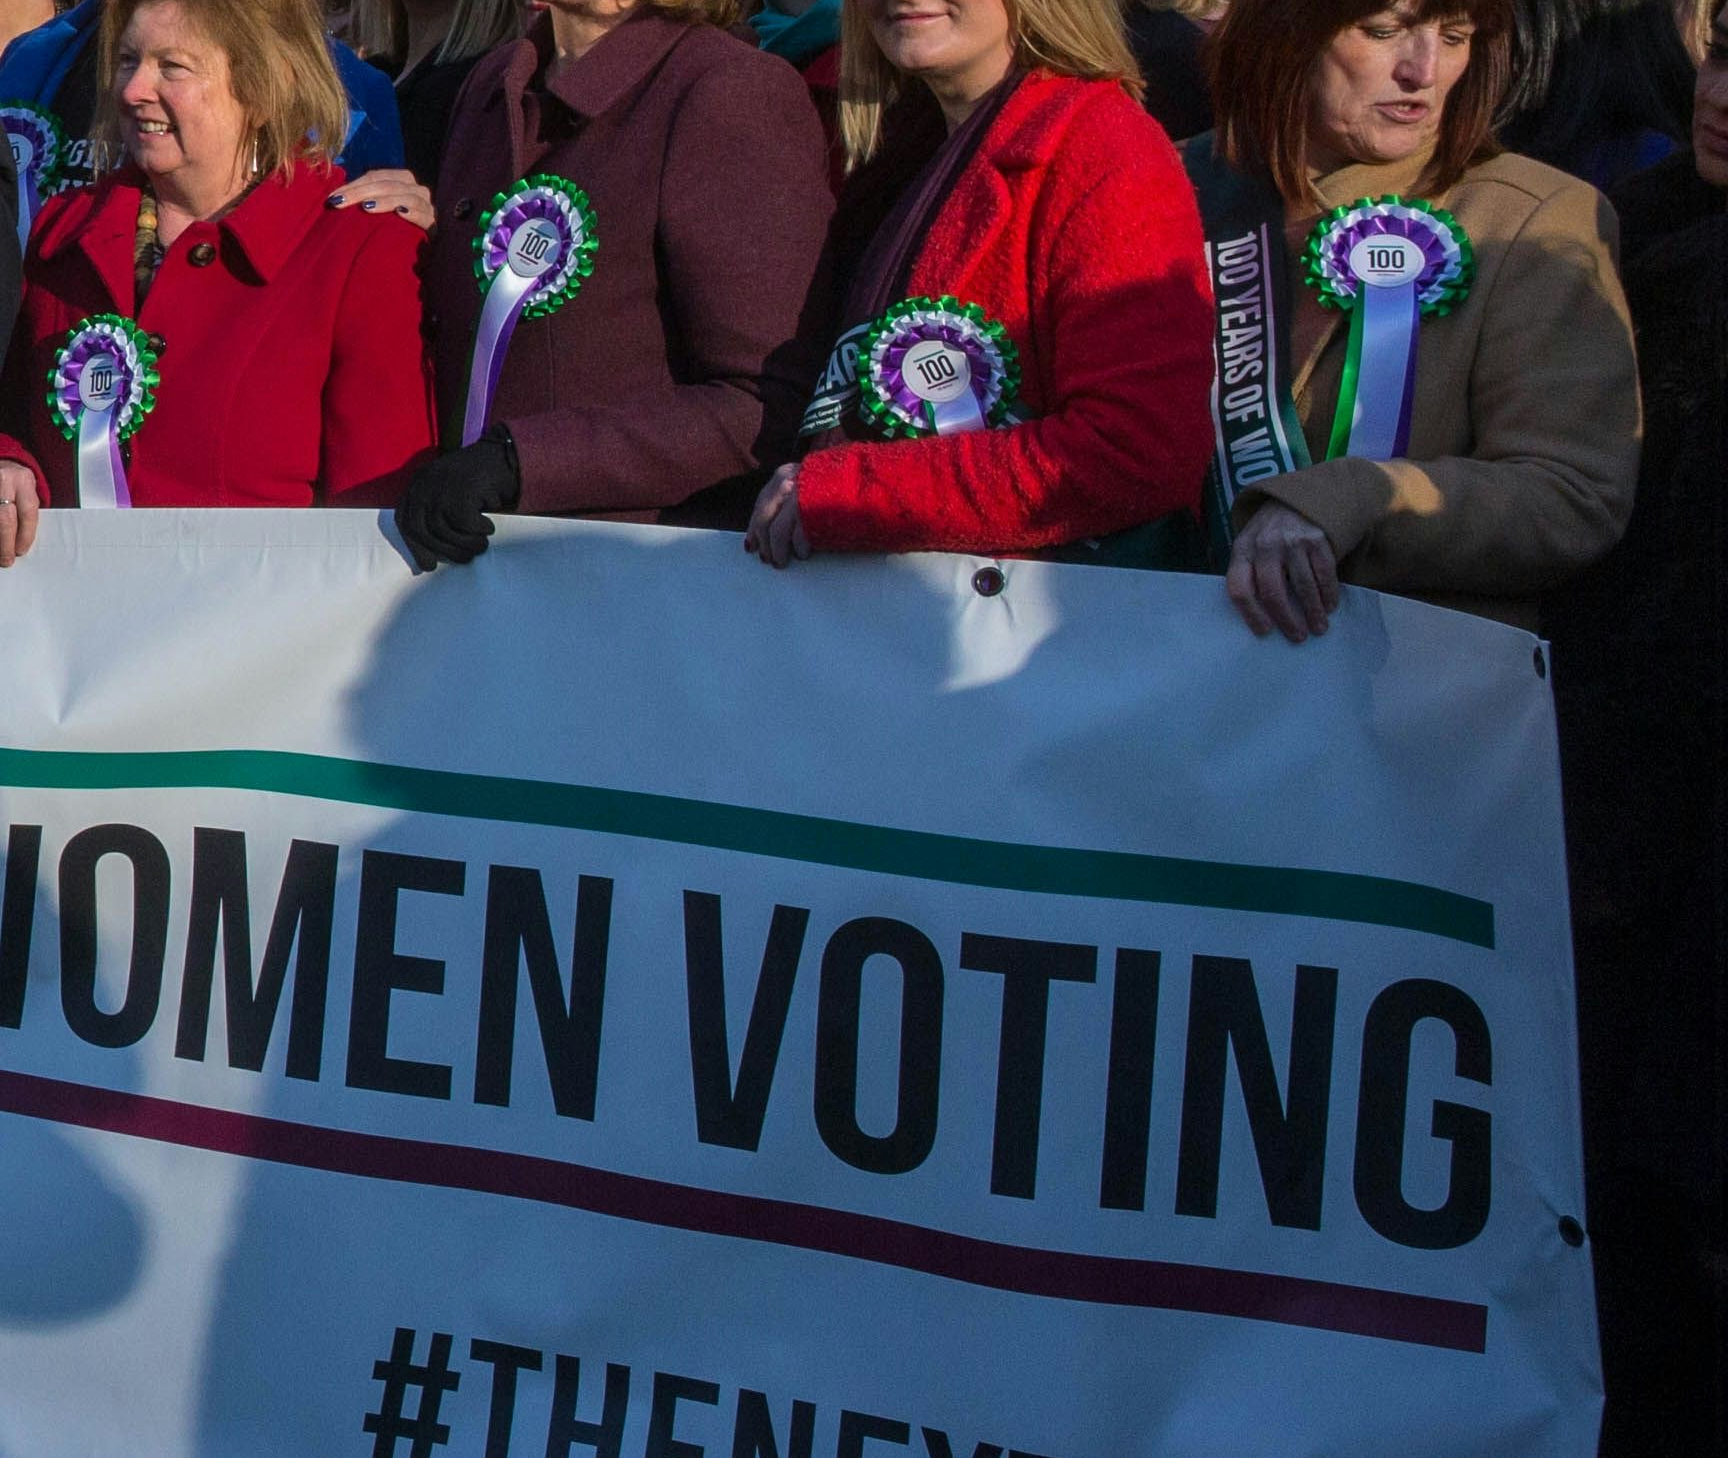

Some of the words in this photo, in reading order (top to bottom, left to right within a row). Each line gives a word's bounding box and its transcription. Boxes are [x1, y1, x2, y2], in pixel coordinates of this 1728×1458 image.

[519, 231, 549, 260] 100
[1217, 230, 1260, 285] 100
[1367, 249, 1405, 269] 100
[1220, 283, 1264, 386] YEARS
[89, 370, 112, 392] 100
[916, 354, 955, 385] 100
[1223, 384, 1265, 423] OF
[683, 890, 1492, 1250] VOTING
